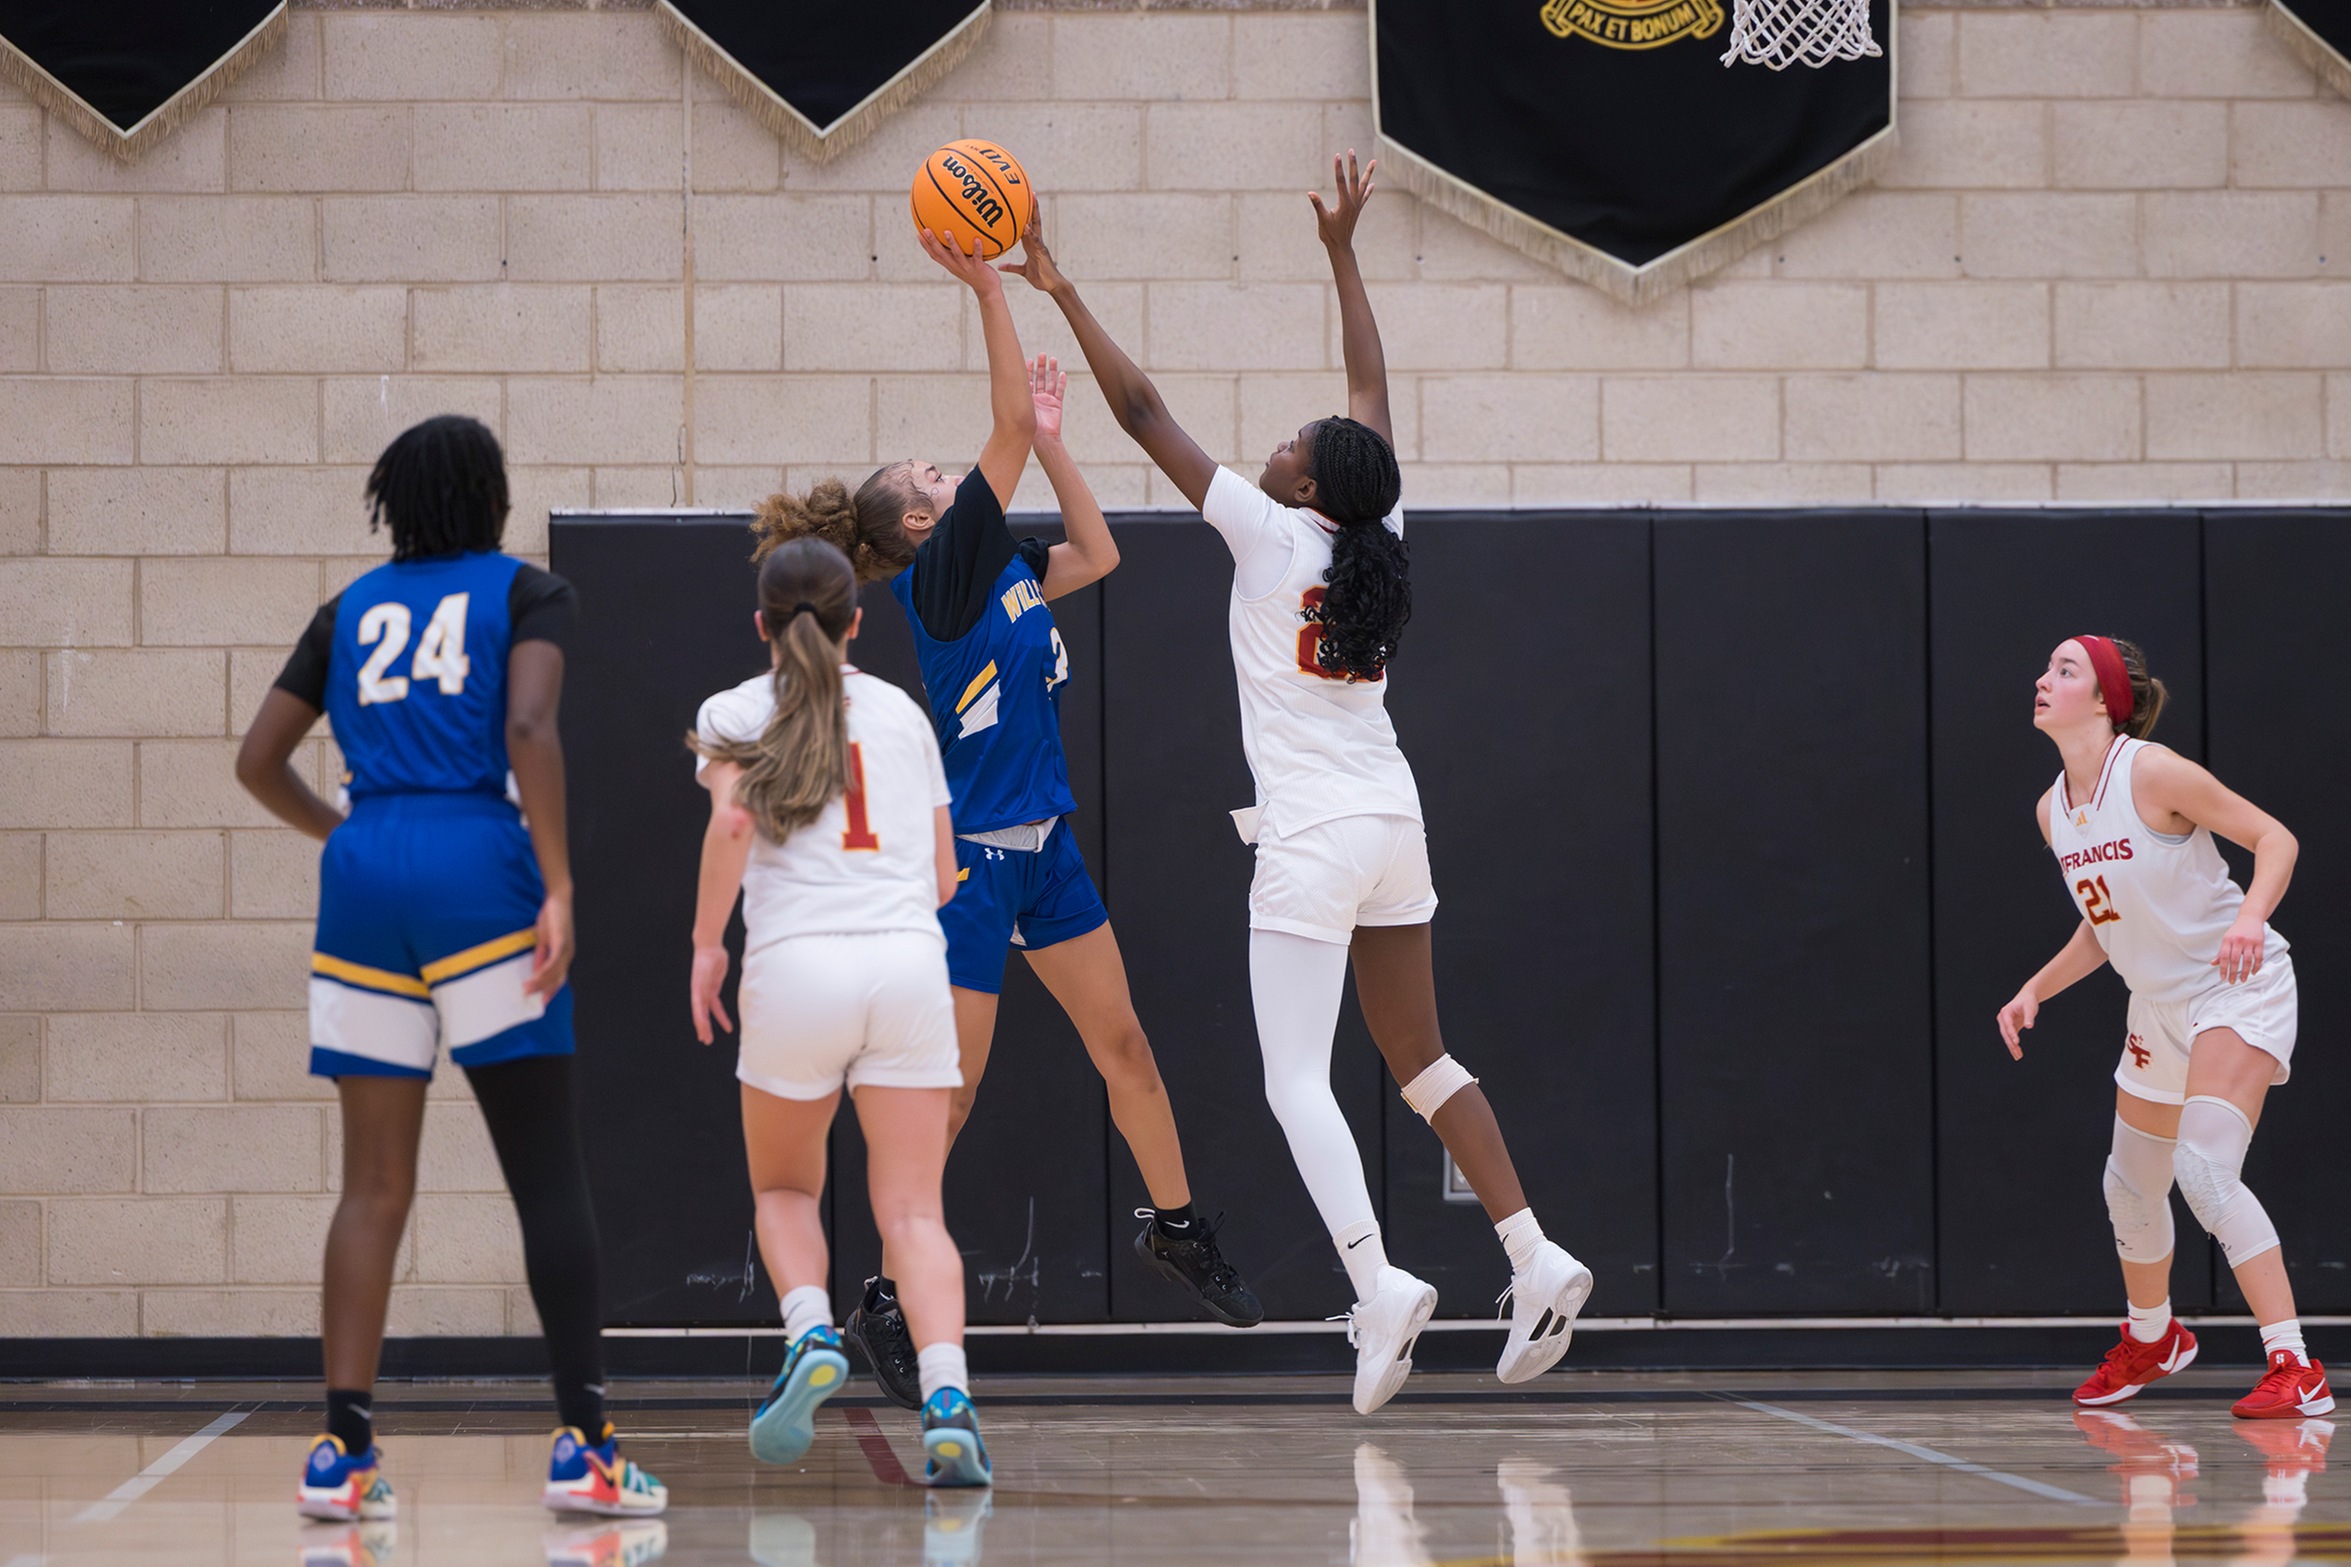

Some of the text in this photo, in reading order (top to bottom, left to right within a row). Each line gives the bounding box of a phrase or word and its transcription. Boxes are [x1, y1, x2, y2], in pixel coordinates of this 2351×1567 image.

[1568, 1, 1697, 42] PAX ET BONUM
[942, 155, 1004, 229] Wilson
[357, 591, 470, 707] 24
[840, 741, 881, 852] 1
[2076, 874, 2122, 926] 21
